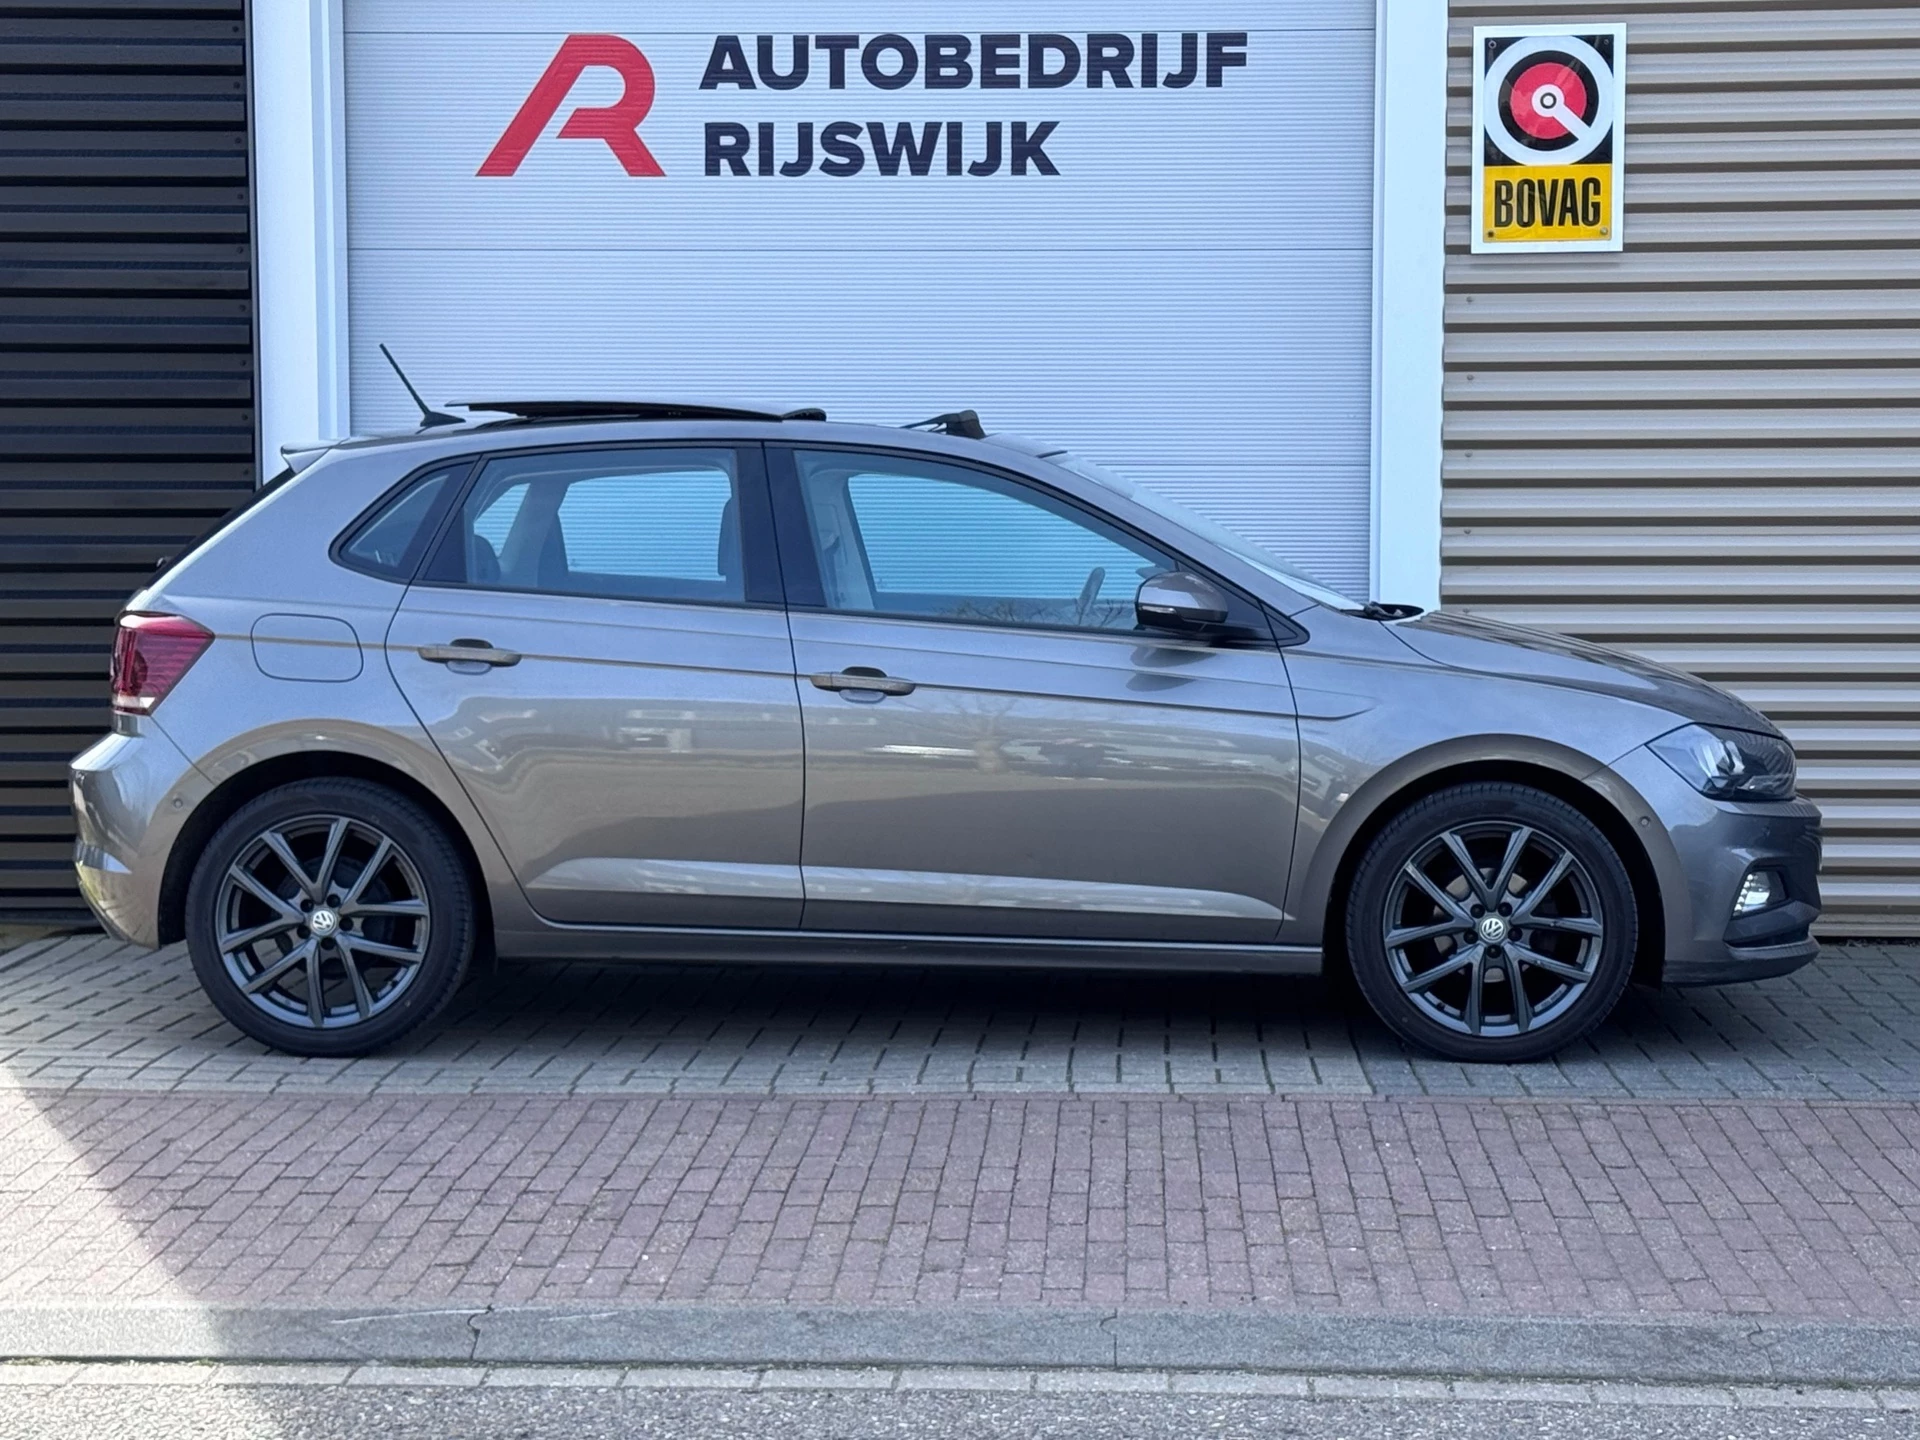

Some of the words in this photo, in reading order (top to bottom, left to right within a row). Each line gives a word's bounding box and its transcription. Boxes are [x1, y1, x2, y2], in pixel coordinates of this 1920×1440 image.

[699, 32, 1248, 90] AUTOBEDRIJF
[704, 121, 1060, 177] RIJSWIJK
[1493, 177, 1602, 228] BOVAG
